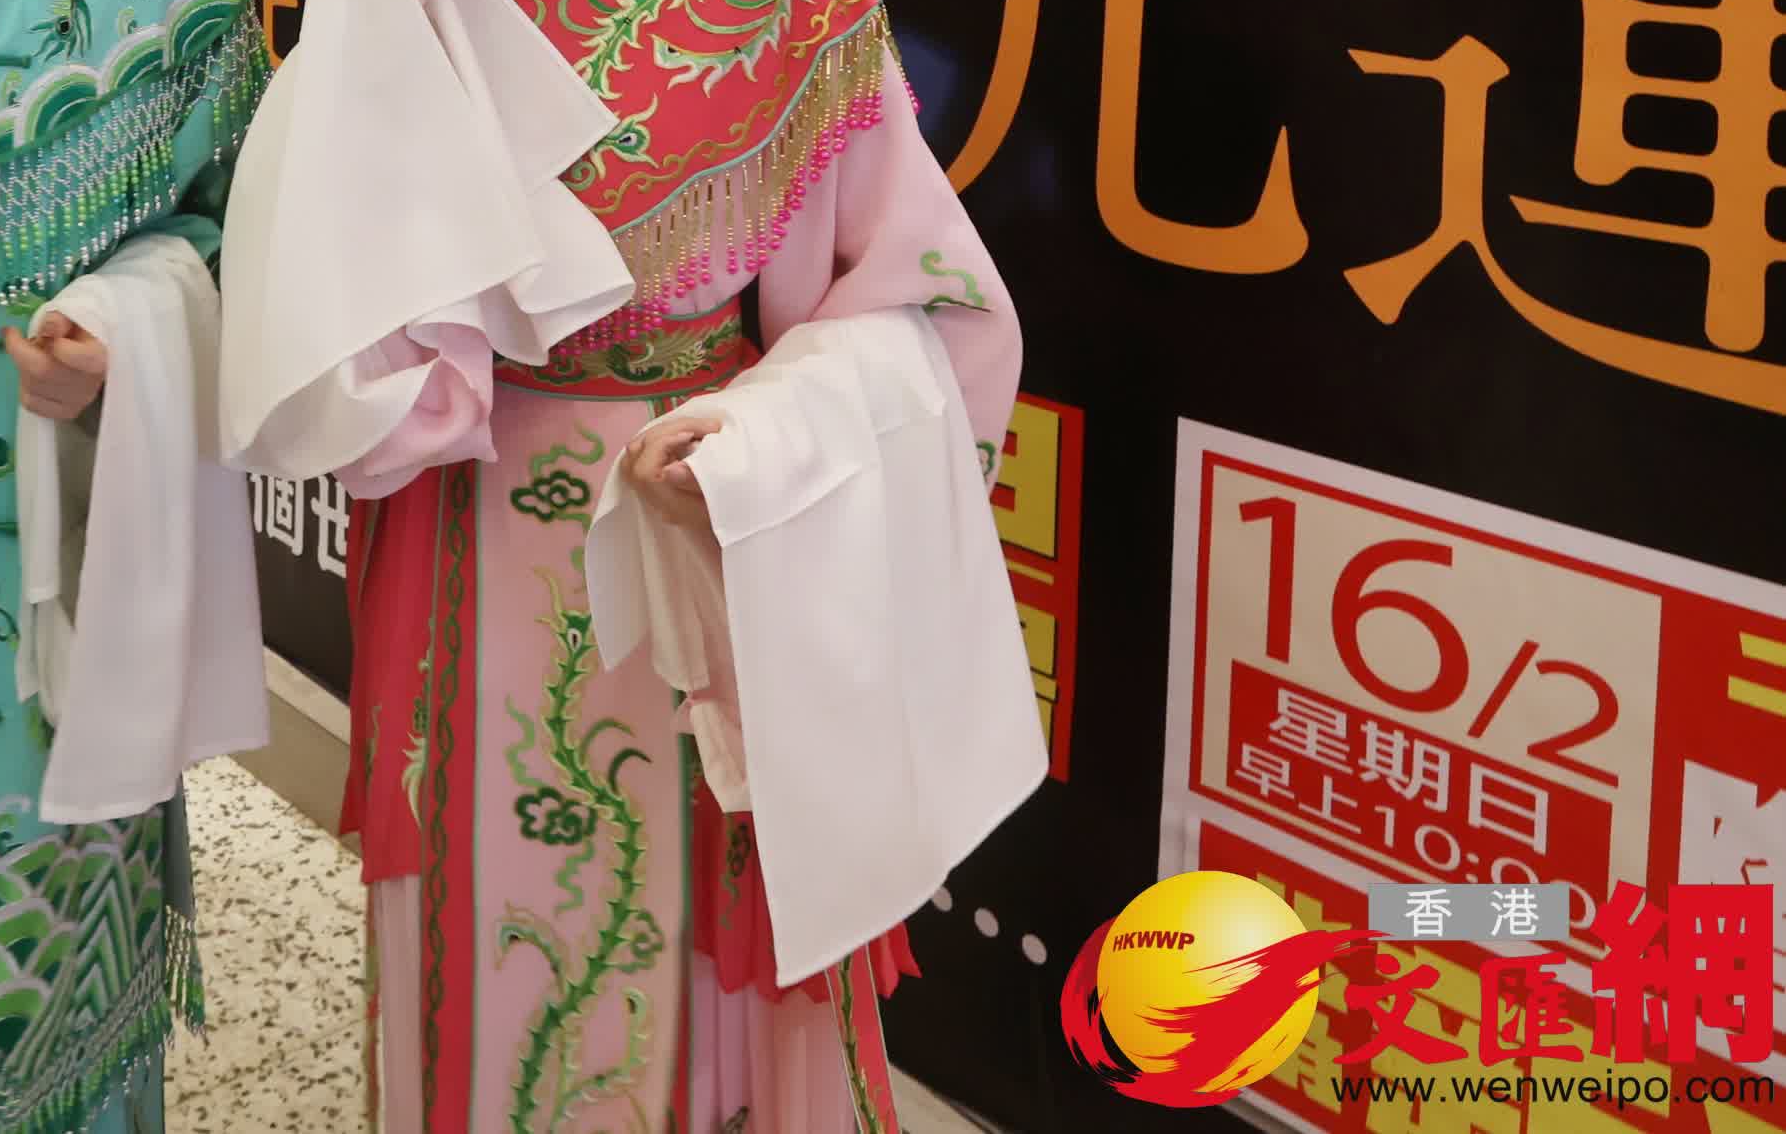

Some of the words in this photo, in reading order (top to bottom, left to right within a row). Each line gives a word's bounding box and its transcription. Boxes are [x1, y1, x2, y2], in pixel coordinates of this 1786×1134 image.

[1240, 499, 1618, 789] 16/2
[1268, 688, 1549, 855] 星期日
